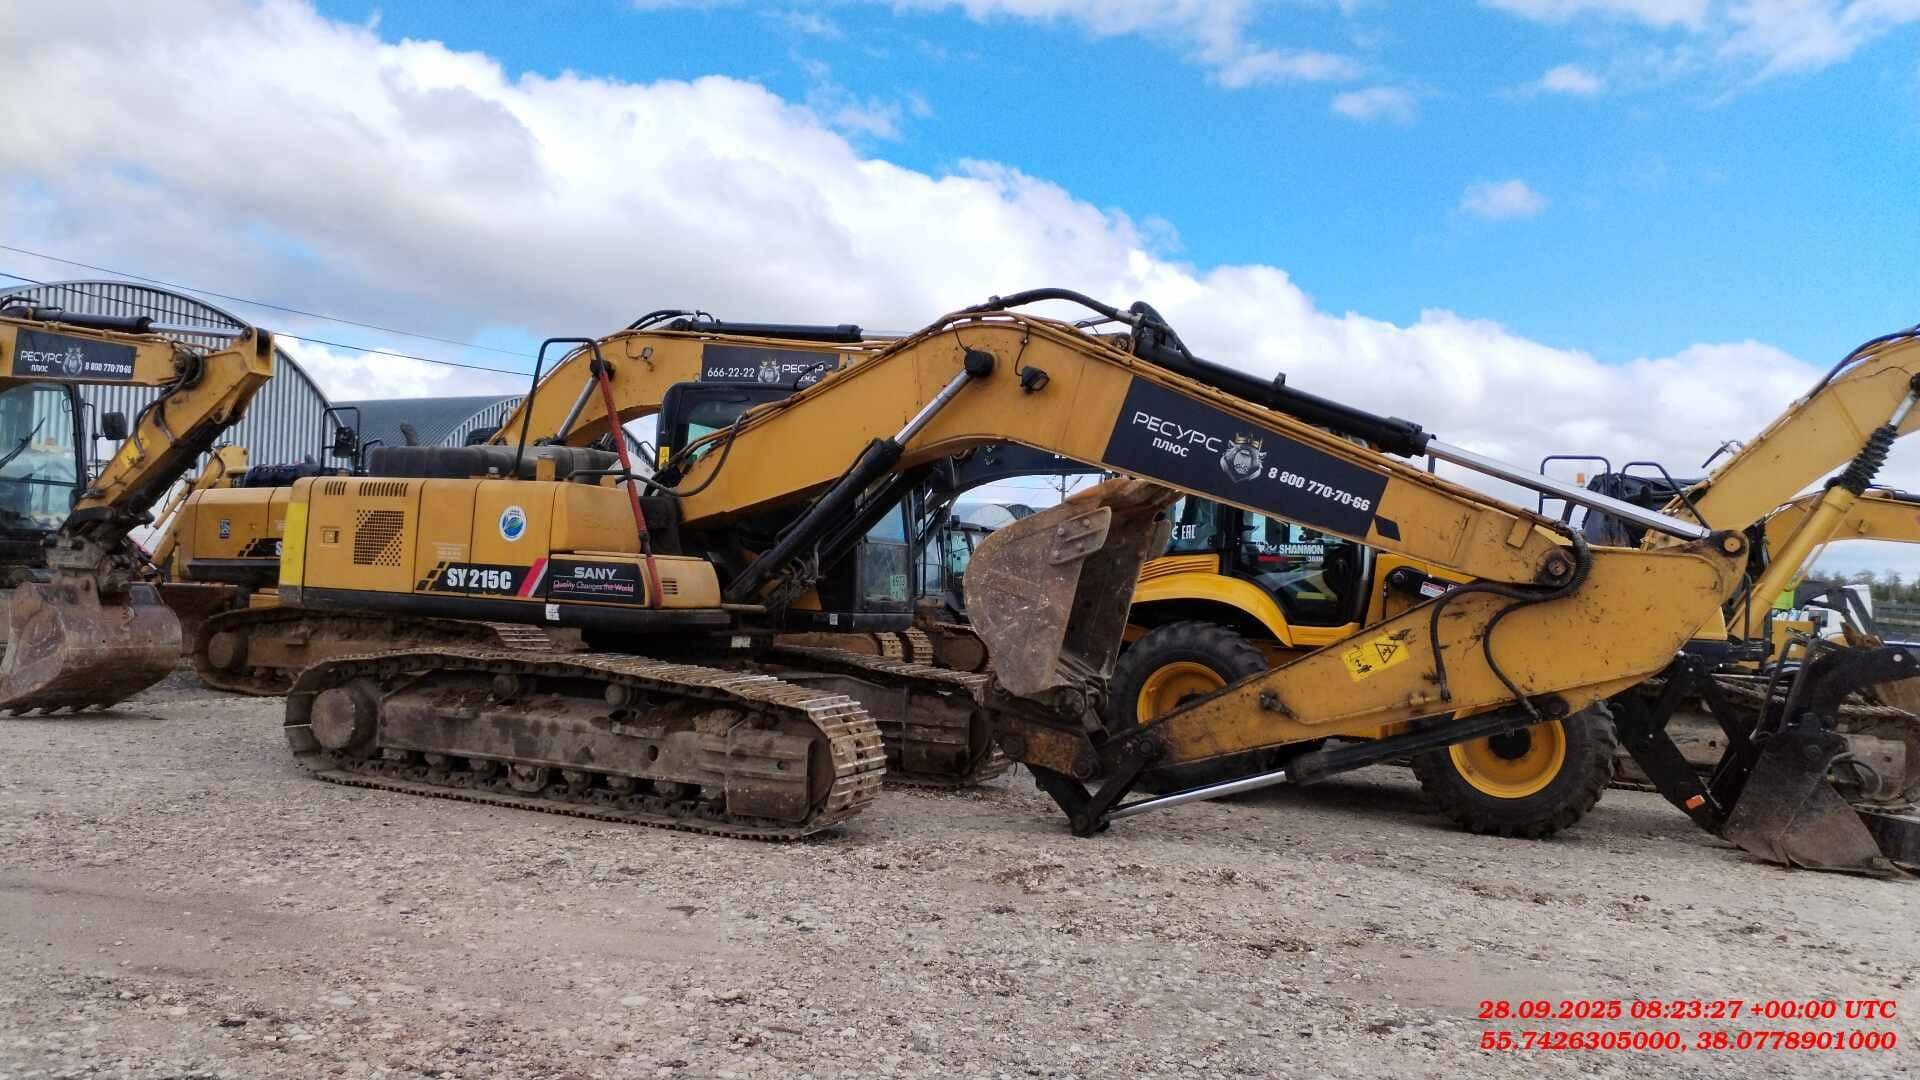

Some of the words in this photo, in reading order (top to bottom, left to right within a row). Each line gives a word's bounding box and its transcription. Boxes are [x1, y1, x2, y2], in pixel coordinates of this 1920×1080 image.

[20, 350, 63, 363] РЕСУРС
[707, 367, 755, 378] 666-22-22
[1132, 411, 1222, 453] РЕСУРС
[1267, 467, 1279, 479] 8
[1279, 471, 1305, 489] 800
[1306, 480, 1371, 511] 770-70-66
[1279, 544, 1324, 555] SHANMON
[574, 566, 616, 579] SANY
[553, 580, 575, 590] Quality
[576, 581, 602, 591] Changes
[615, 583, 634, 592] World
